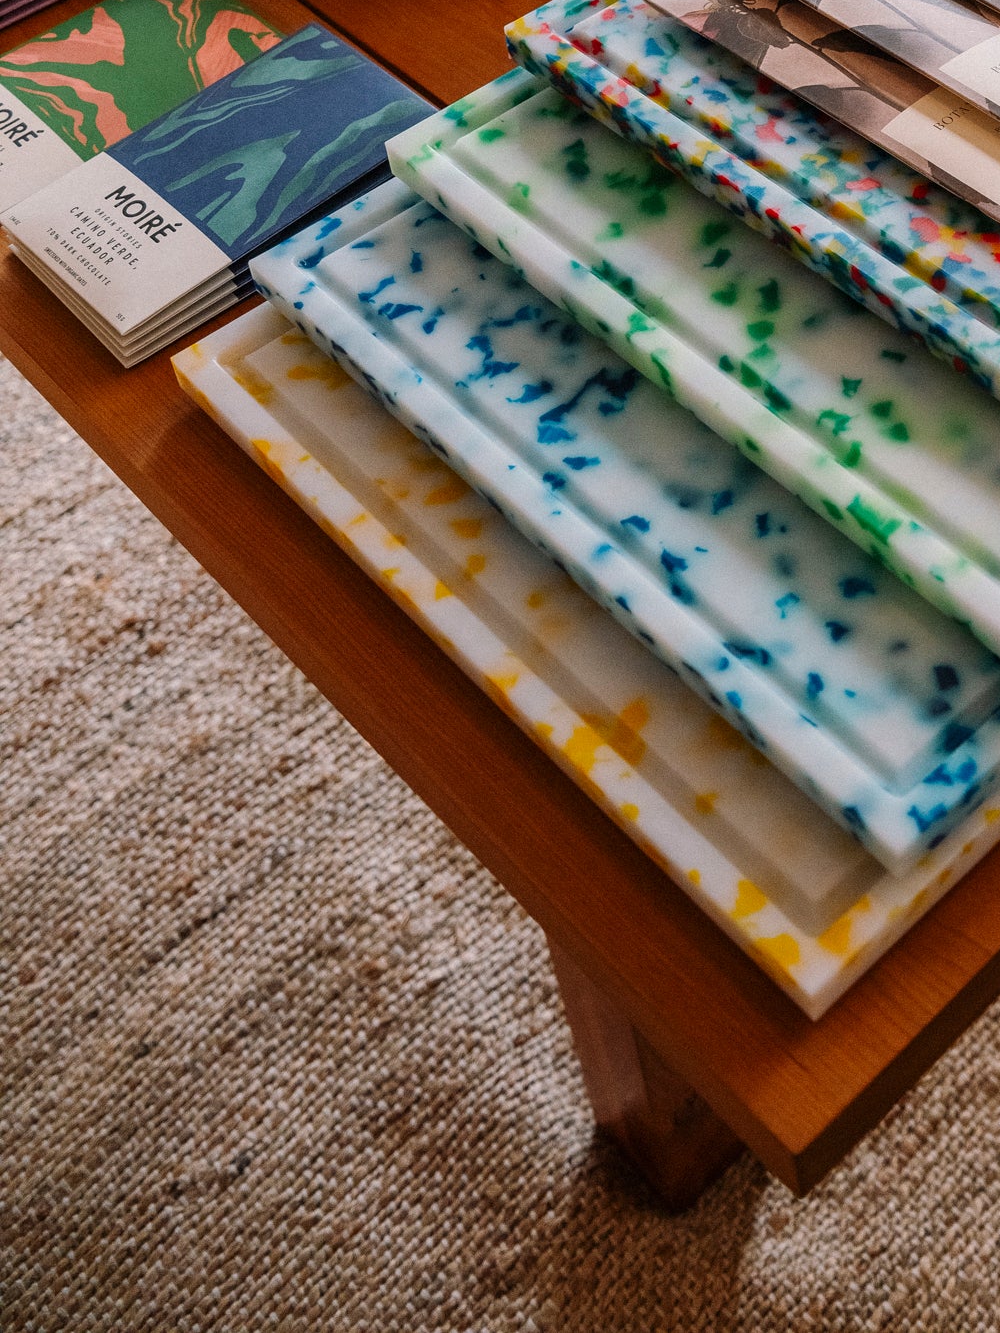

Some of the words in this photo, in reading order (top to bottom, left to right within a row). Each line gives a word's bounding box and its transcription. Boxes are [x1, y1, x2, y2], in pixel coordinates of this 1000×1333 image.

[69, 206, 106, 237] CAMINO
[106, 237, 139, 270] VERDE,
[94, 208, 118, 227] ORIGIN
[115, 226, 142, 249] STORIES
[104, 185, 183, 244] MOIRÉ
[46, 227, 60, 241] 70%
[60, 239, 77, 256] DARK
[76, 254, 112, 286] CHOCOLATE
[70, 227, 114, 266] ECUADOR
